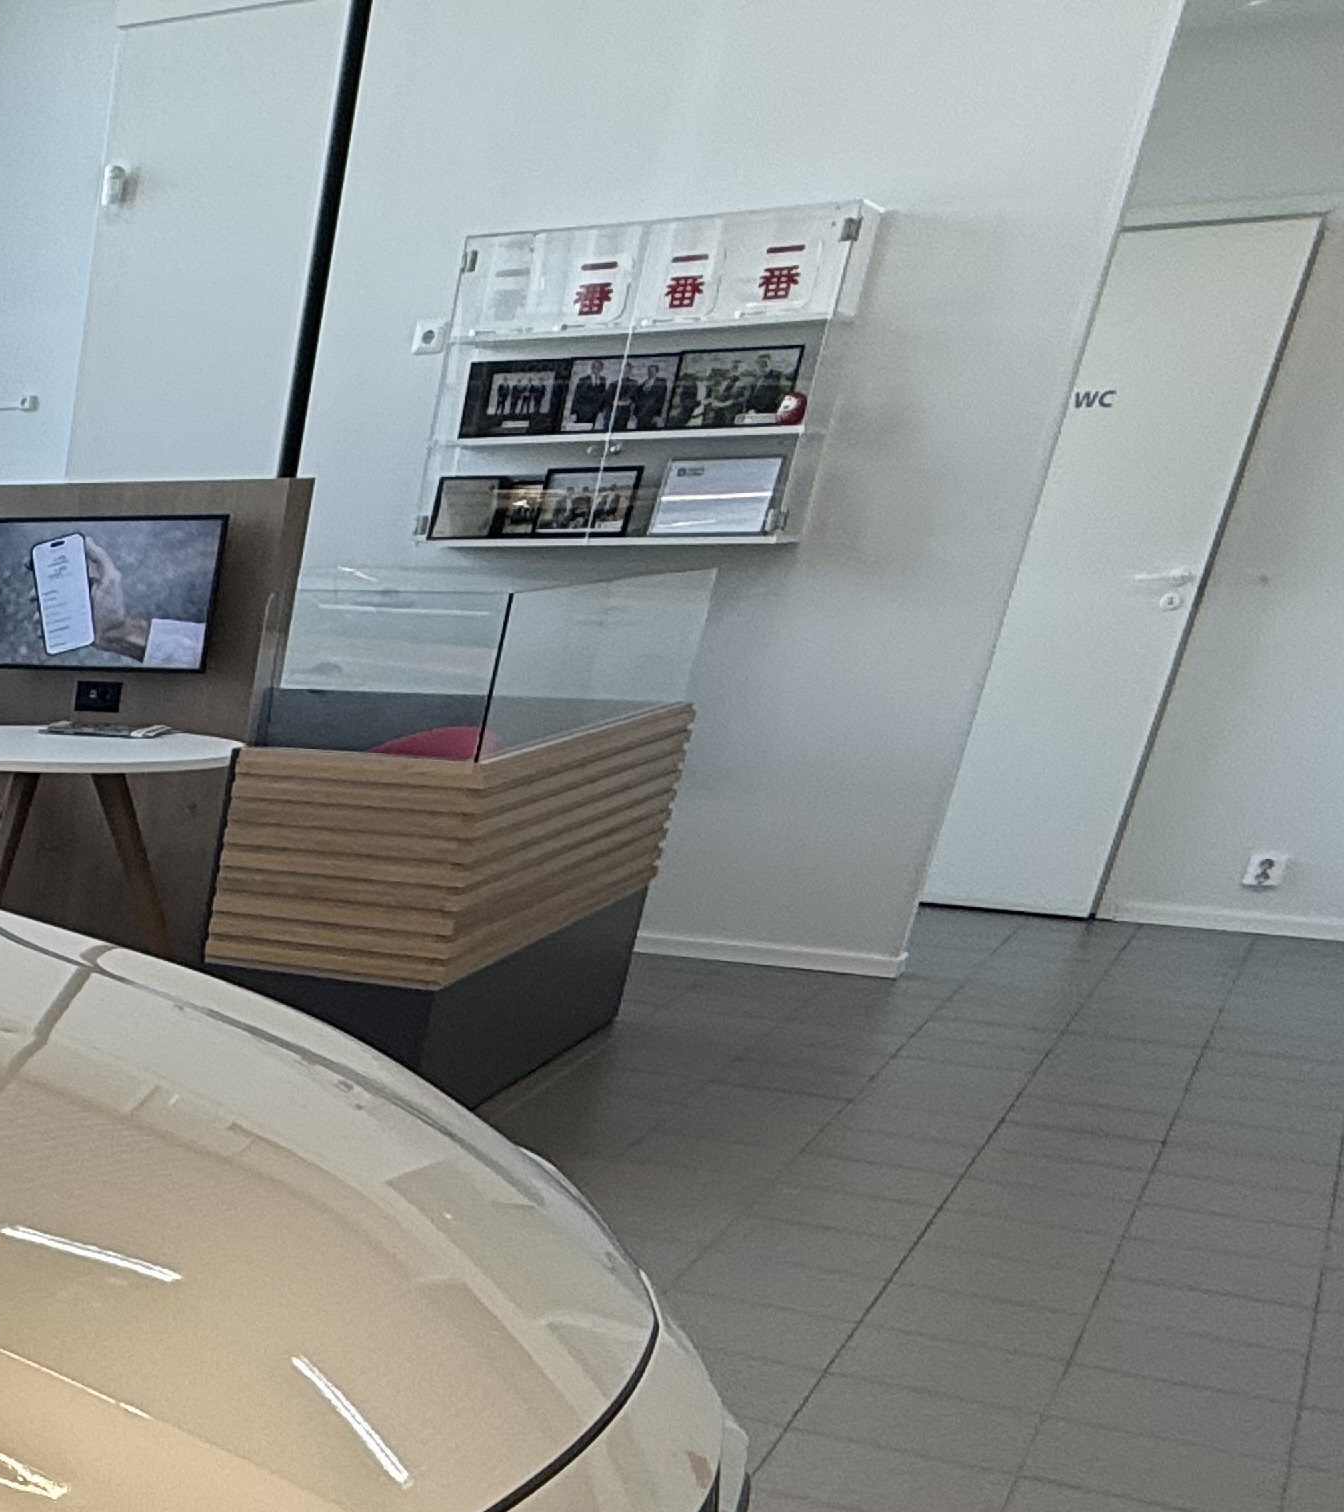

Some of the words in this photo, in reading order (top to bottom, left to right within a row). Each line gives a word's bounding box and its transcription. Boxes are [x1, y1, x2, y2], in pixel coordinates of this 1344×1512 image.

[573, 260, 619, 316] 一番
[664, 253, 710, 308] 一番
[759, 244, 806, 301] 一番
[1075, 390, 1116, 408] WC
